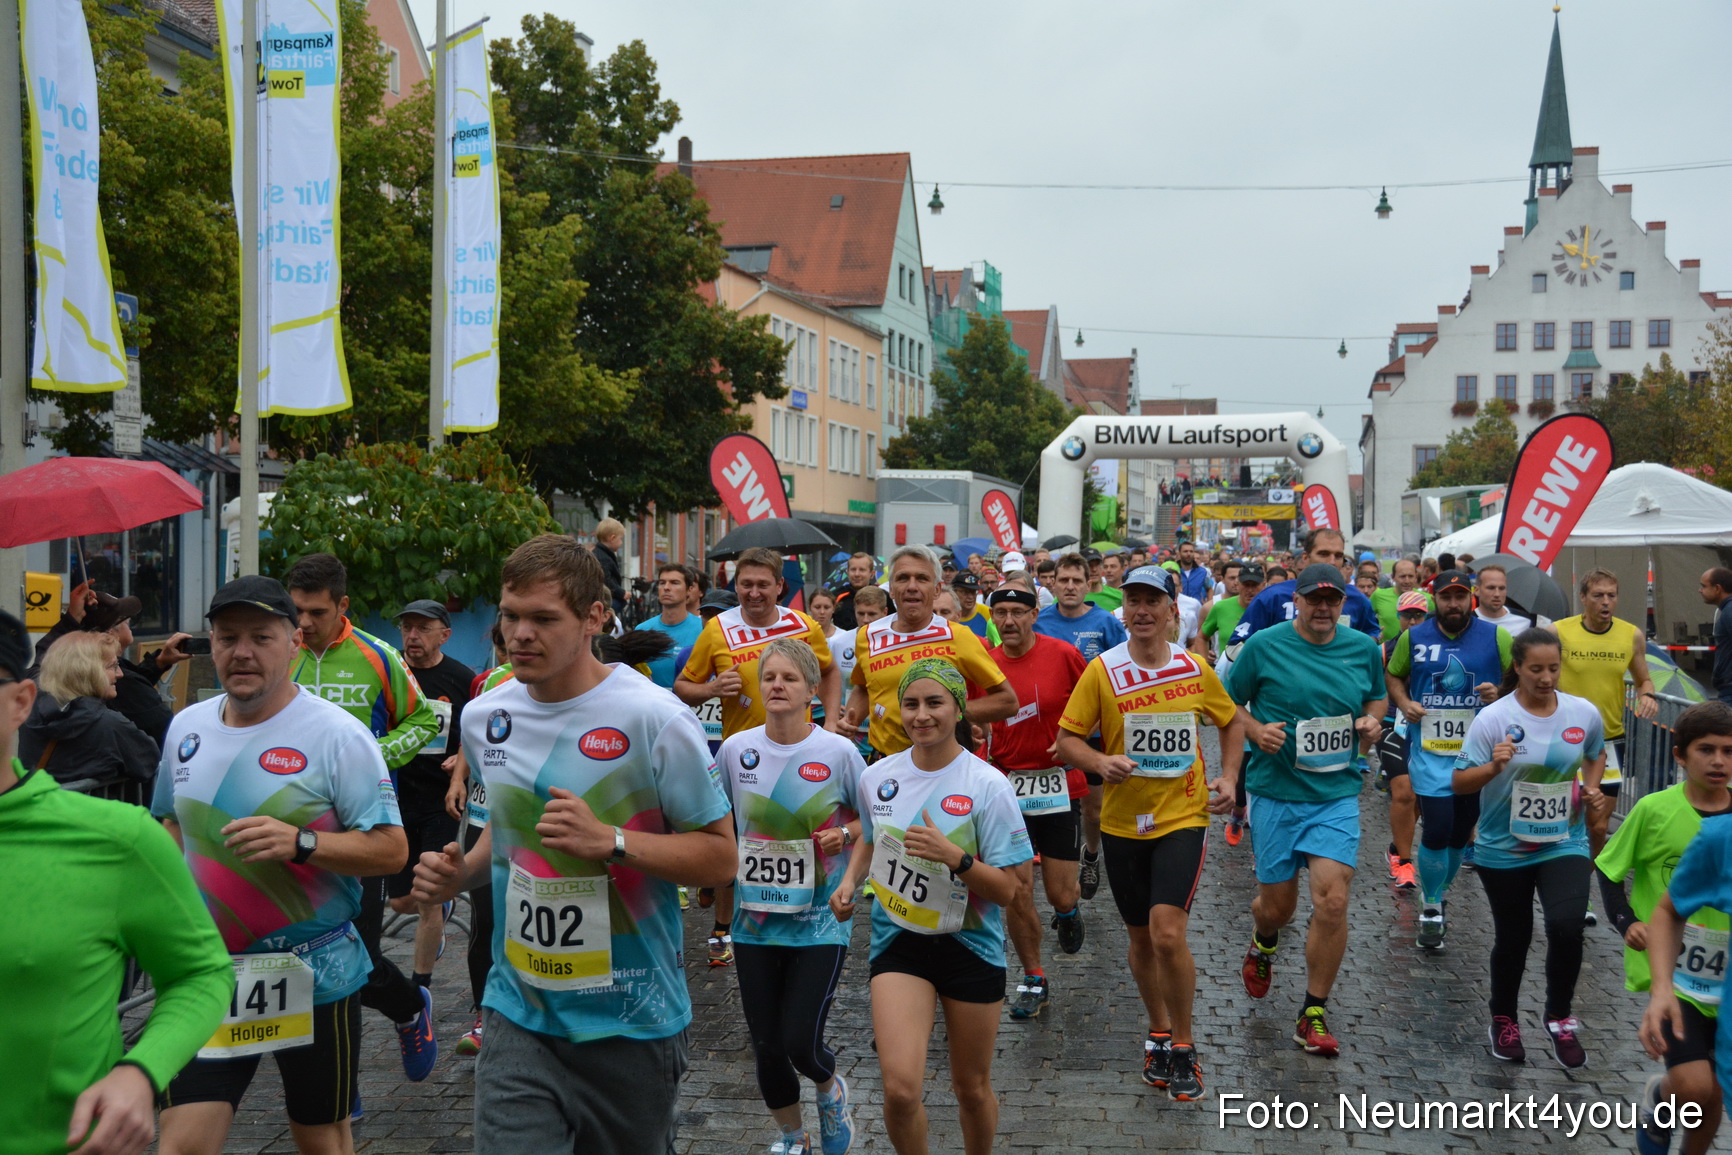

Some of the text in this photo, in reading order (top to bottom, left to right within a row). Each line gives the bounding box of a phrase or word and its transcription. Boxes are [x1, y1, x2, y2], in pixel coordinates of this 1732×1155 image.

[1095, 423, 1288, 448] BMW Laufsport
[1508, 434, 1598, 566] REWE
[1233, 508, 1256, 517] ZIEL
[869, 646, 956, 673] MAX BÖGL
[1414, 643, 1441, 663] 21
[1571, 651, 1626, 660] KLINGELE
[1117, 682, 1204, 714] MAX BÖGL
[1432, 721, 1466, 738] 194
[585, 735, 624, 752] Hervis
[1132, 728, 1191, 752] 2688
[1303, 728, 1350, 753] 3066
[266, 753, 302, 769] Hervis
[483, 750, 508, 760] PARTL
[1141, 758, 1180, 768] Andreas
[739, 772, 758, 781] PARTL
[803, 767, 828, 778] Hervis
[1015, 774, 1062, 797] 2793
[873, 804, 893, 813] PARTL
[945, 799, 971, 811] Hervis
[1026, 799, 1054, 809] Helmut
[1519, 796, 1567, 820] 2334
[1528, 824, 1559, 834] Tamara
[768, 843, 807, 852] BOCK
[745, 856, 805, 885] 2591
[535, 880, 596, 896] BOCK
[887, 858, 930, 903] 175
[761, 890, 789, 902] Ulrike
[888, 896, 908, 917] Lina
[520, 899, 584, 948] 202
[251, 956, 303, 970] BOCK
[527, 953, 573, 975] Tobias
[231, 1023, 280, 1042] Holger
